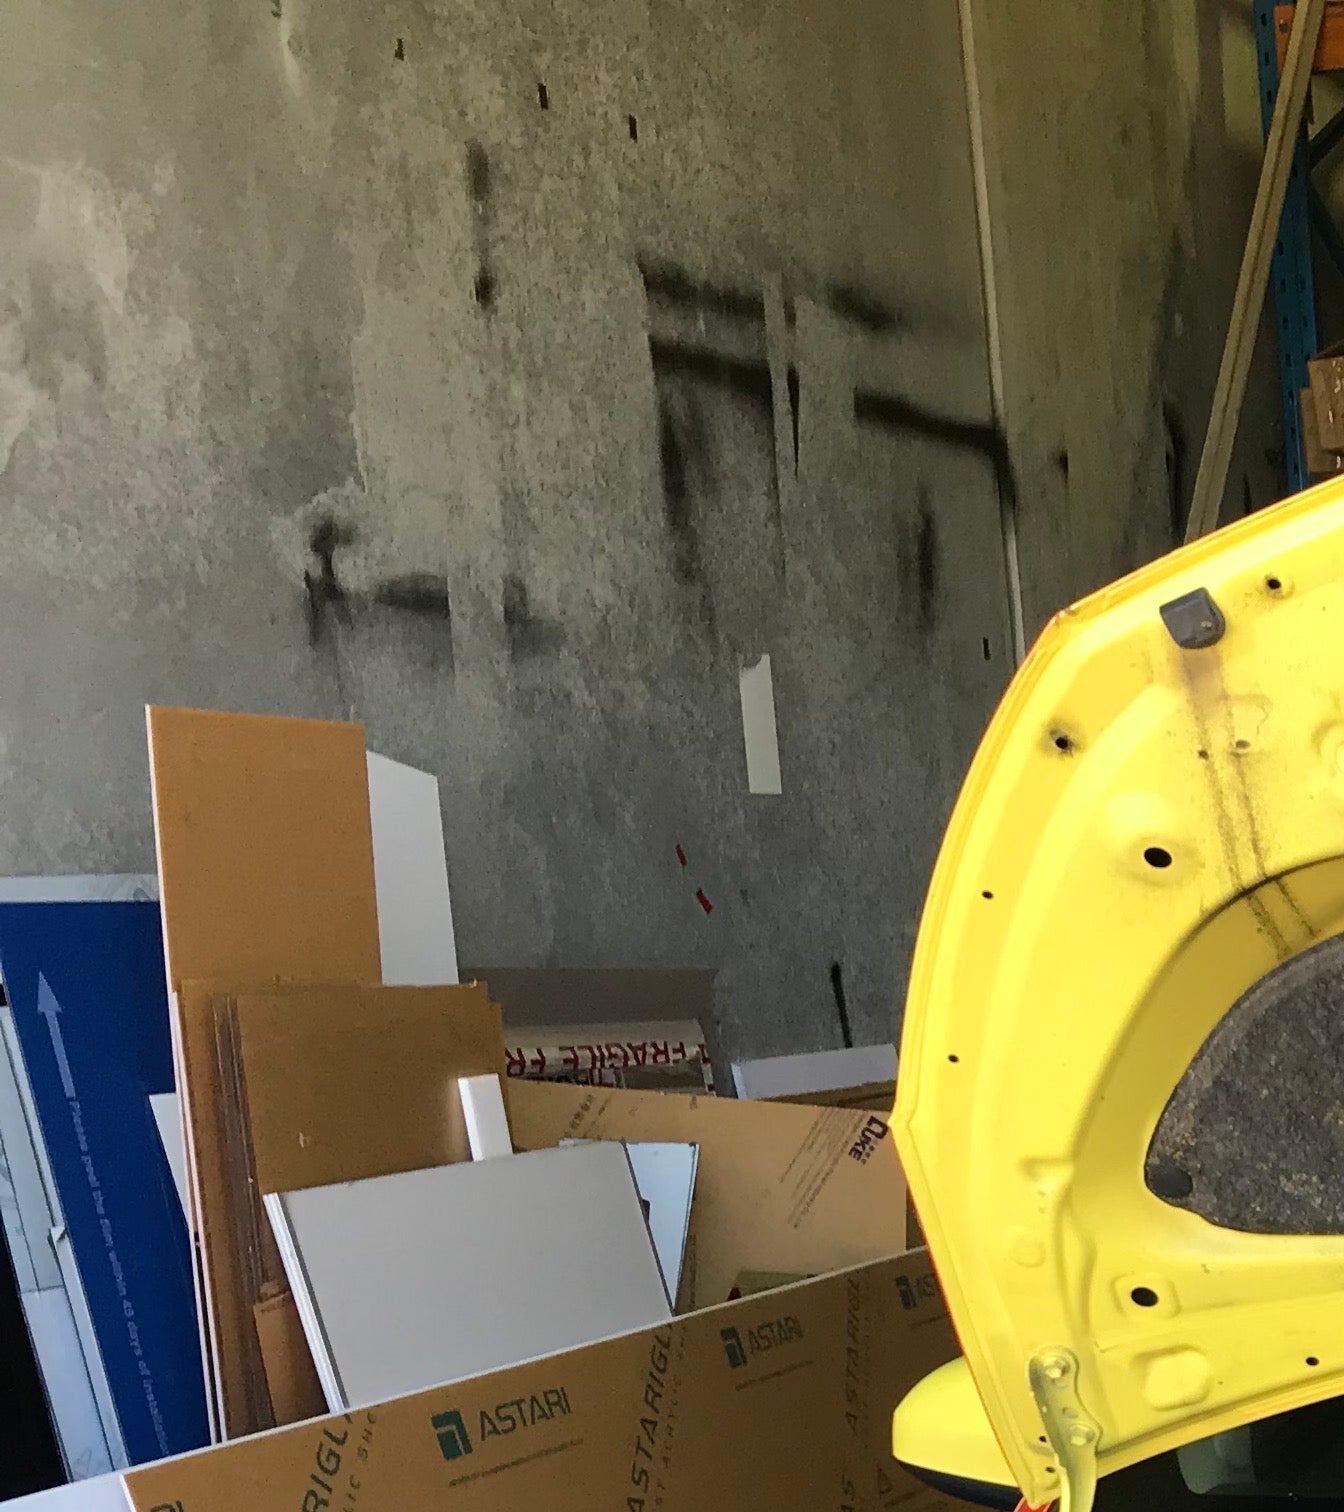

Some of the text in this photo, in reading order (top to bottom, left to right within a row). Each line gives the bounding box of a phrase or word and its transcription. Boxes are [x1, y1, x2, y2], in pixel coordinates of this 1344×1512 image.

[558, 1040, 687, 1071] FRAGILE
[746, 1315, 804, 1354] ASTARI
[479, 1386, 572, 1442] ASTARI
